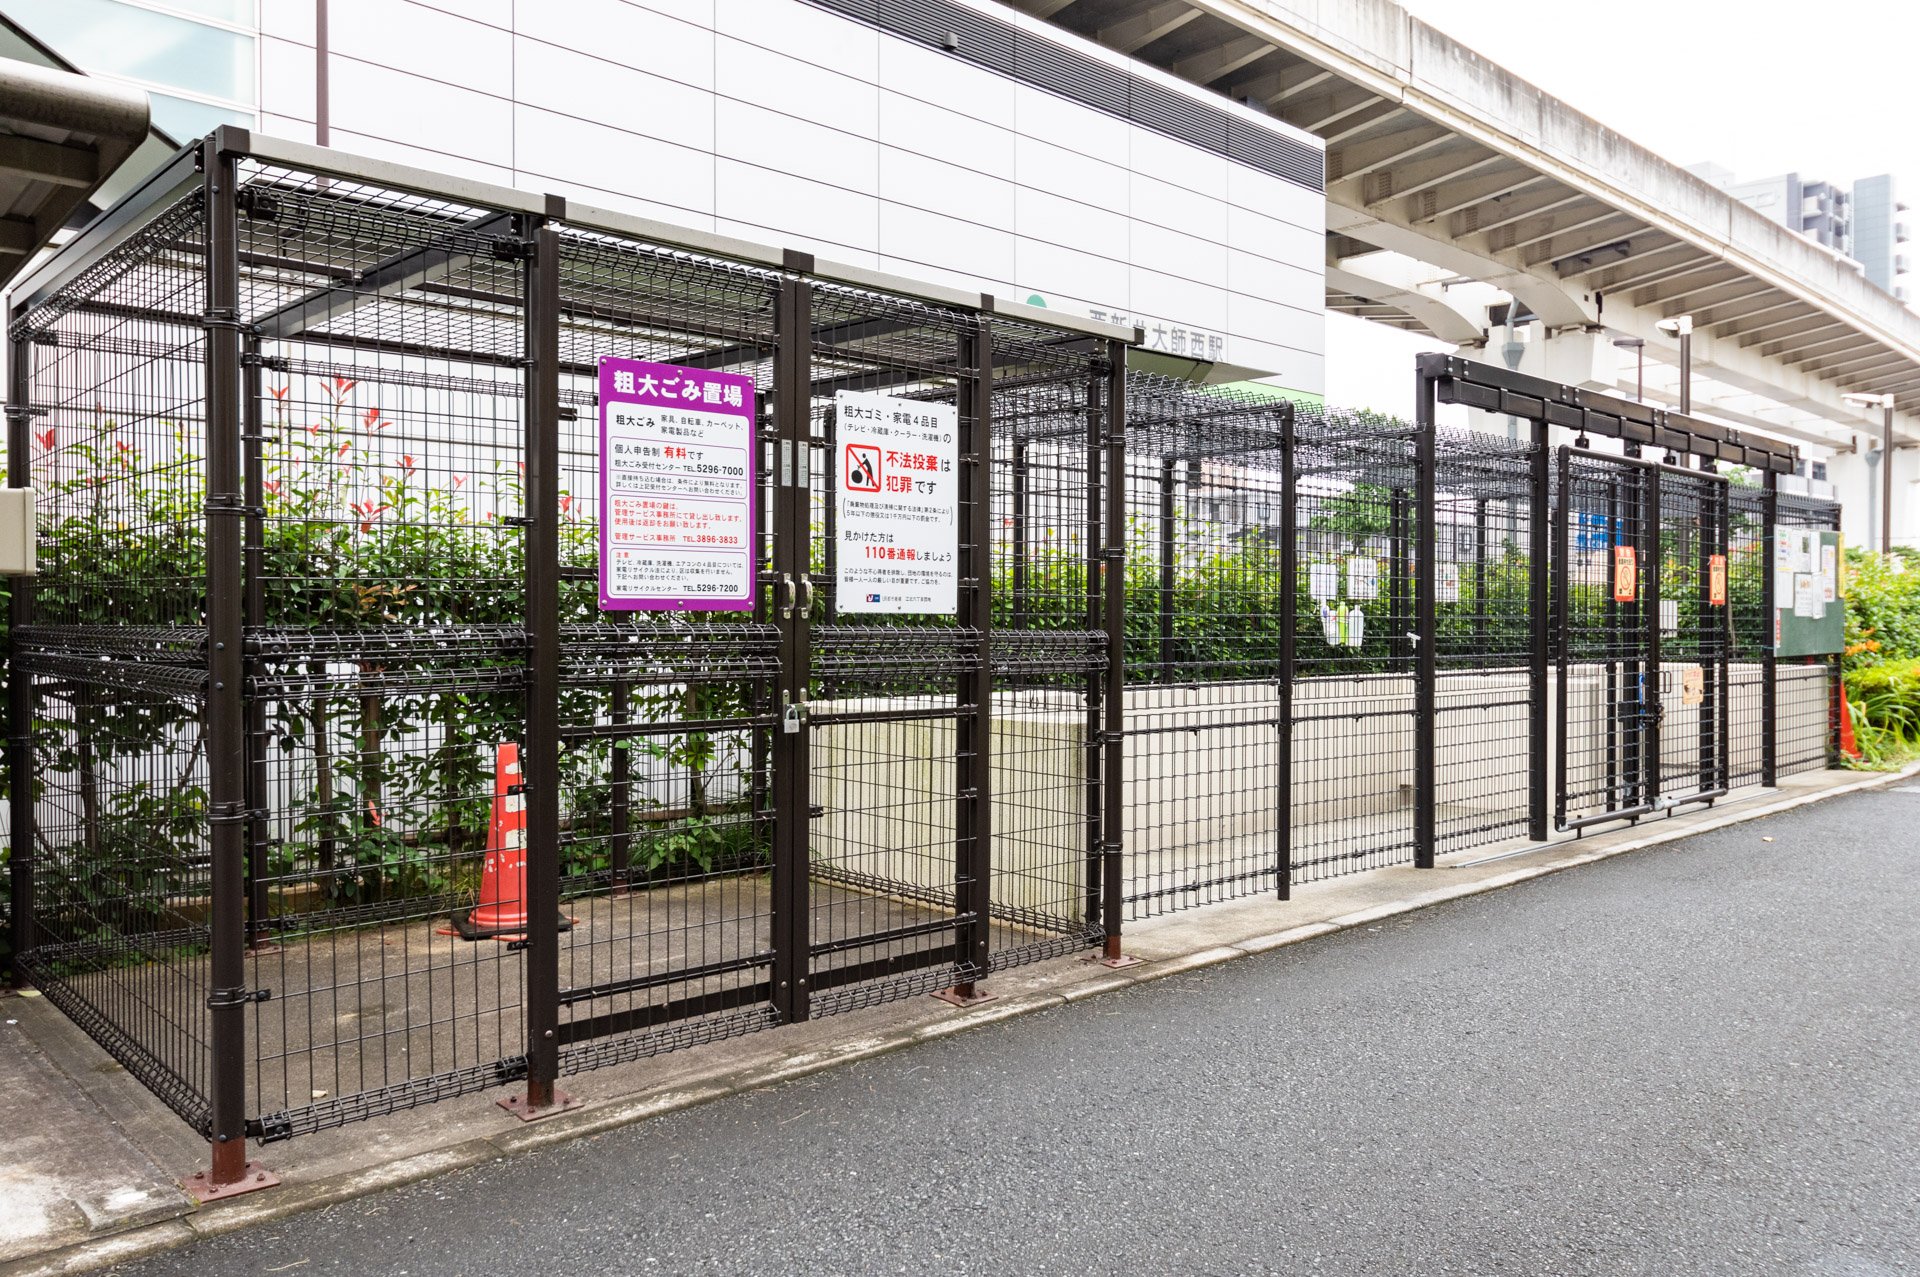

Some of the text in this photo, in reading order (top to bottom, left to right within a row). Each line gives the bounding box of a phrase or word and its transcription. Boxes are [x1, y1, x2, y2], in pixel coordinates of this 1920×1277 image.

[613, 369, 743, 407] 粗大ごみ置場
[616, 414, 655, 428] 粗大ごみ
[660, 427, 704, 438] 家電製品など
[614, 444, 661, 458] 個人申告制
[614, 459, 681, 471] 粗大ごみ受付センター
[886, 475, 937, 495] 犯罪です
[614, 532, 676, 542] 管理サービス事務所
[844, 530, 894, 543] 見かけた方は
[865, 545, 952, 562] 110番通報しましょう
